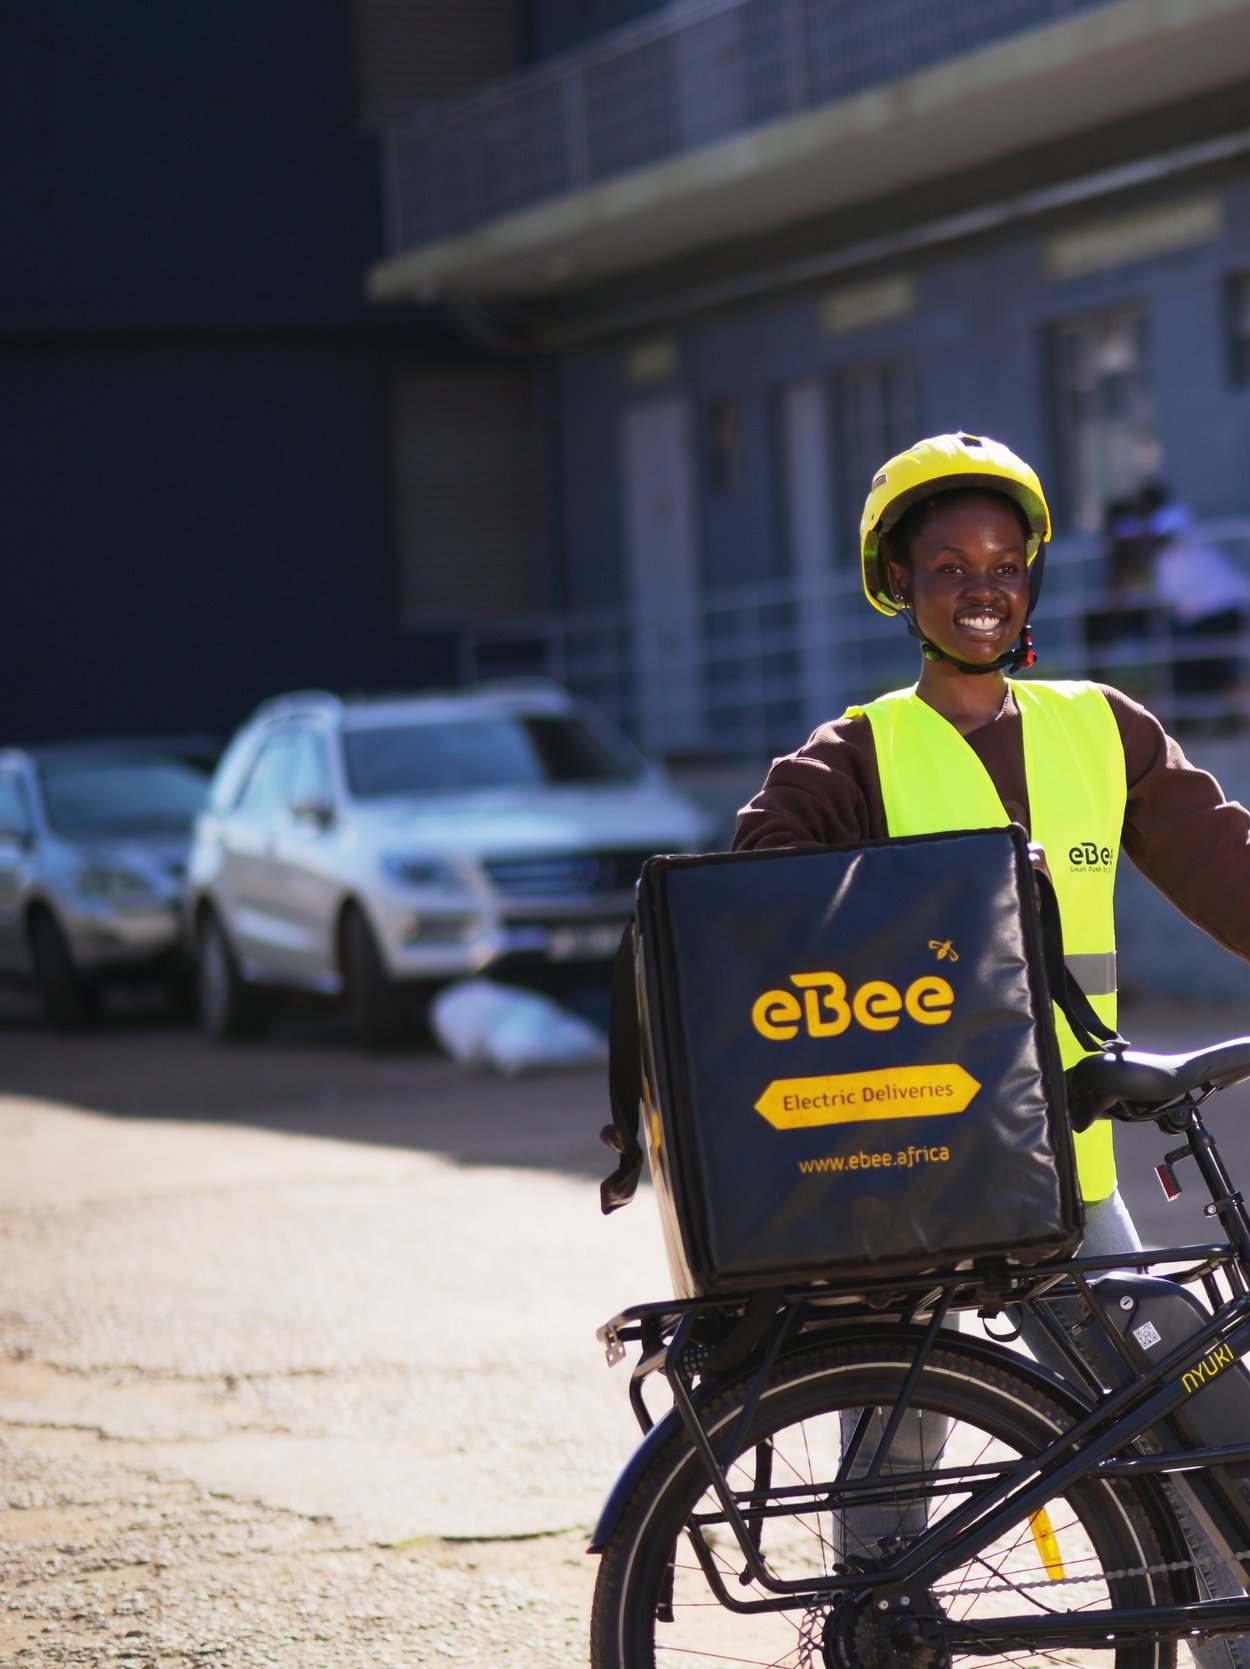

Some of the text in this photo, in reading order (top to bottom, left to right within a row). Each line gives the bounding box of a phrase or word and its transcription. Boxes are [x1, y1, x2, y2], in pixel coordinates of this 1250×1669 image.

[1069, 842, 1113, 865] eBe
[752, 971, 955, 1040] eBee
[783, 1083, 954, 1112] Electric Deliveries
[799, 1146, 950, 1173] www.ebee.africa
[1182, 1343, 1234, 1393] NYUKI
